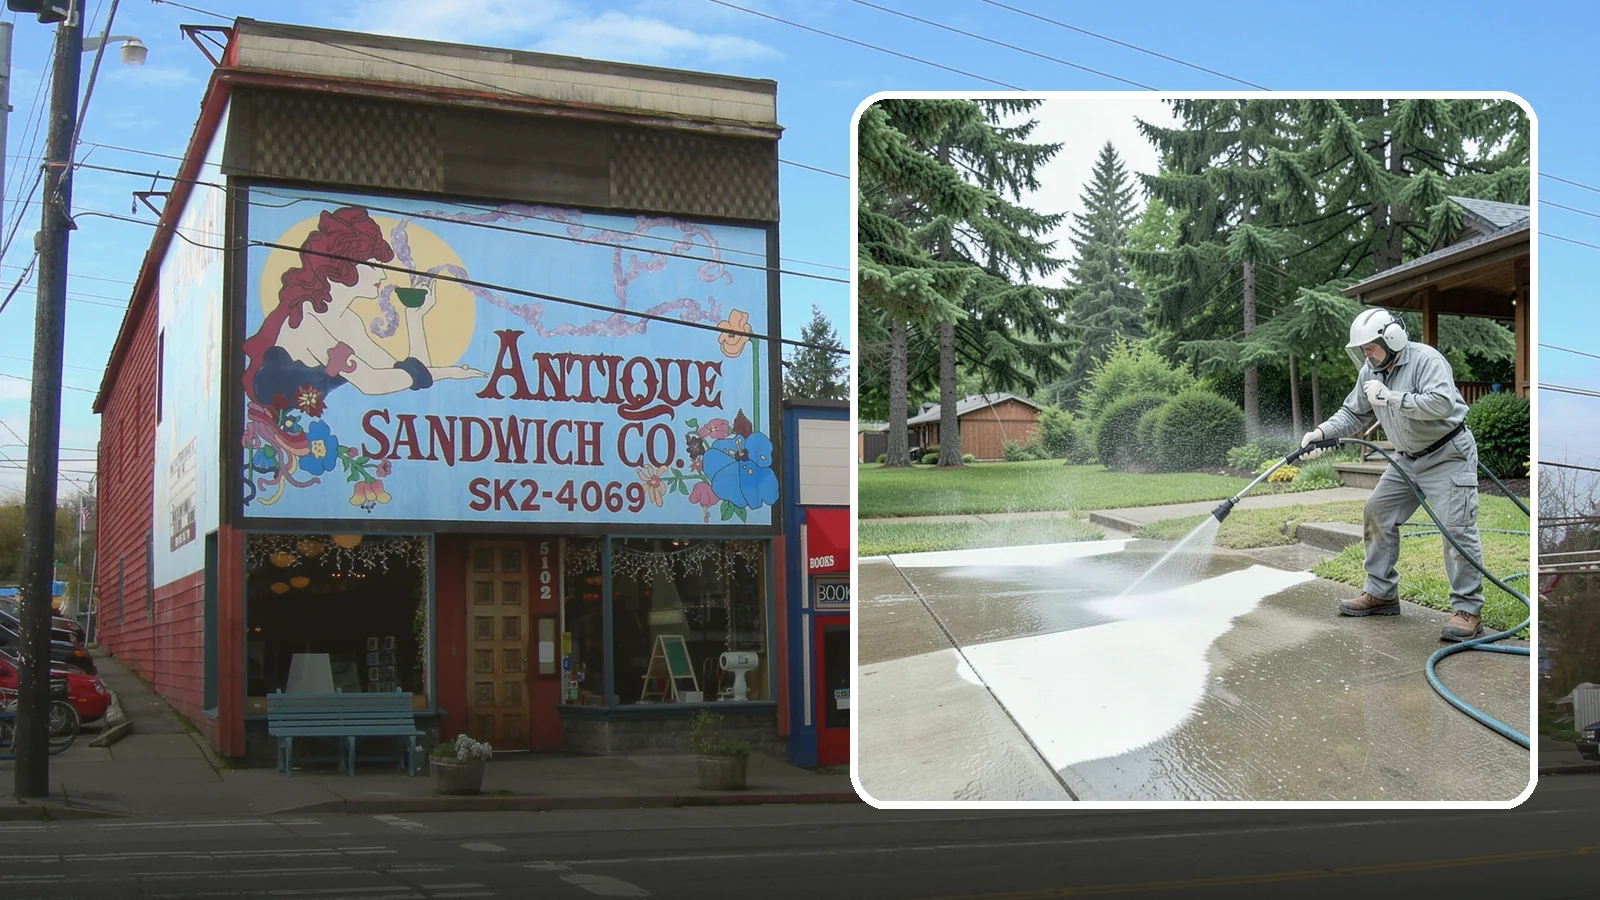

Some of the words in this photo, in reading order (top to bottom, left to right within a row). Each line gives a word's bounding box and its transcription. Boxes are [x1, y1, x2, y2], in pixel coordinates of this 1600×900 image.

[476, 330, 723, 421] ANTIQUE
[362, 409, 604, 467] SANDWICH
[617, 422, 685, 468] CO.
[469, 477, 645, 512] SK2-4069
[540, 541, 551, 600] 5102
[809, 555, 834, 569] BOOKS
